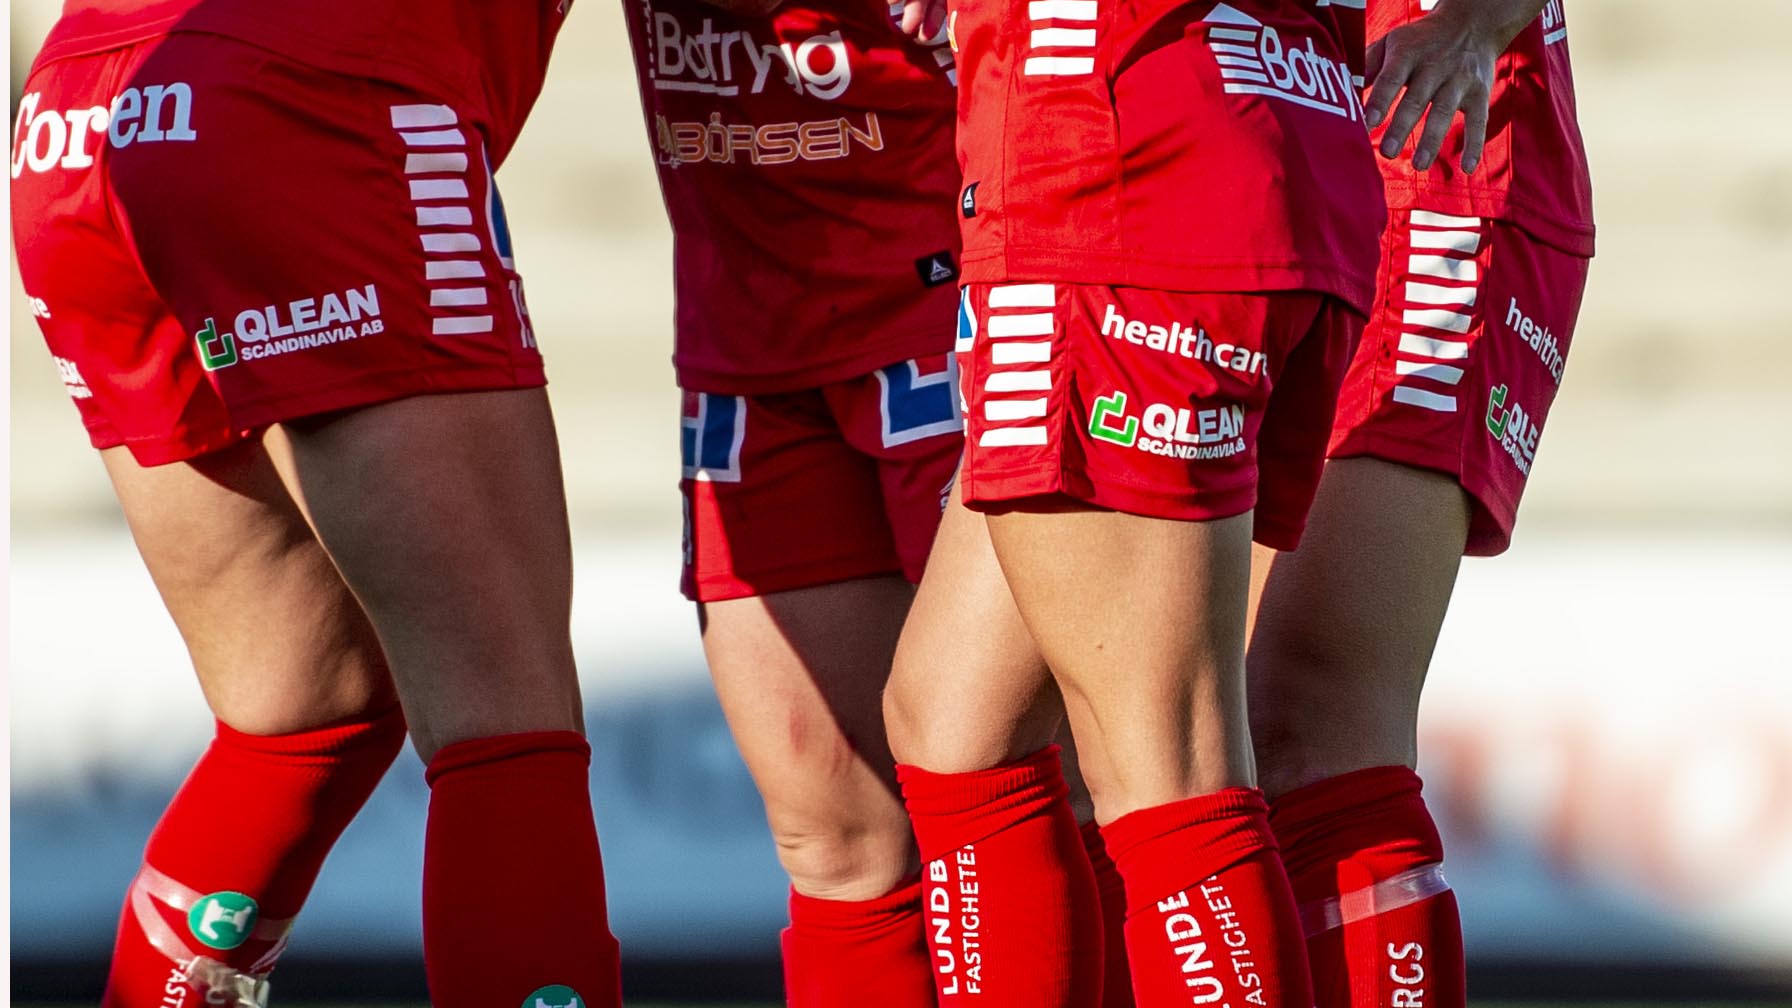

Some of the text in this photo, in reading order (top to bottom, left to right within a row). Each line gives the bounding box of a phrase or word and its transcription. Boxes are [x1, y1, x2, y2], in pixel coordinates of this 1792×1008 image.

[234, 284, 381, 343] QLEAN
[241, 319, 385, 361] SCANDINAVIA AB
